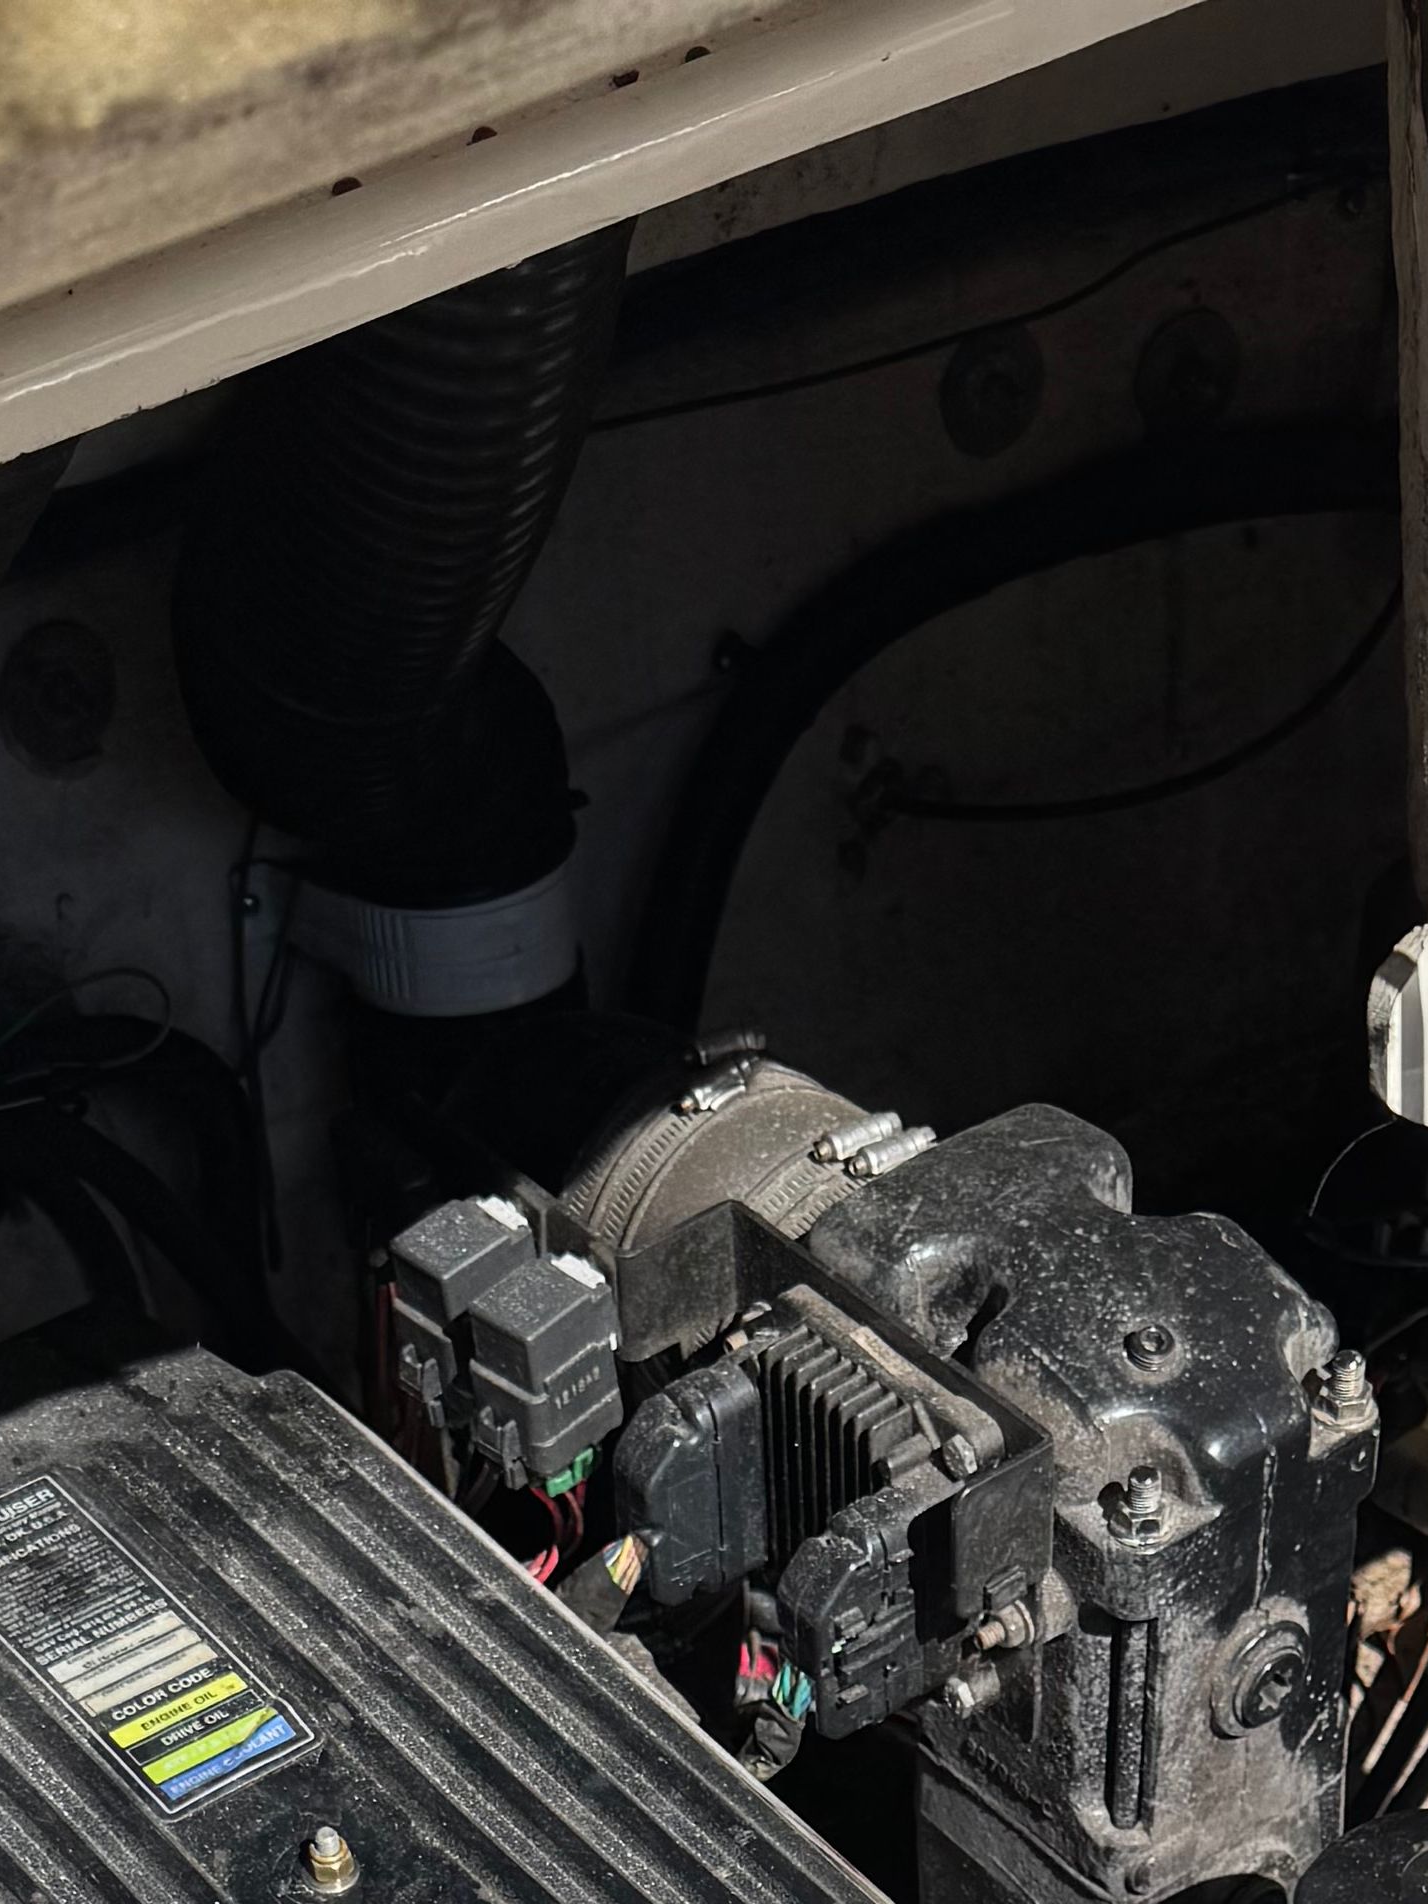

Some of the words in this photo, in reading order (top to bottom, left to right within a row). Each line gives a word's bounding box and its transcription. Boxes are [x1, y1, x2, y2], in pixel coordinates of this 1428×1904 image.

[33, 1632, 94, 1666] SERIAL
[89, 1596, 170, 1640] NUMBERS
[109, 1688, 170, 1722] COLOR
[165, 1666, 214, 1695] CODE
[139, 1700, 193, 1732] ENGINE
[191, 1688, 218, 1706] OIL
[159, 1719, 205, 1747] DRIVE
[201, 1707, 230, 1726] OIL
[168, 1763, 223, 1795] ENGINE
